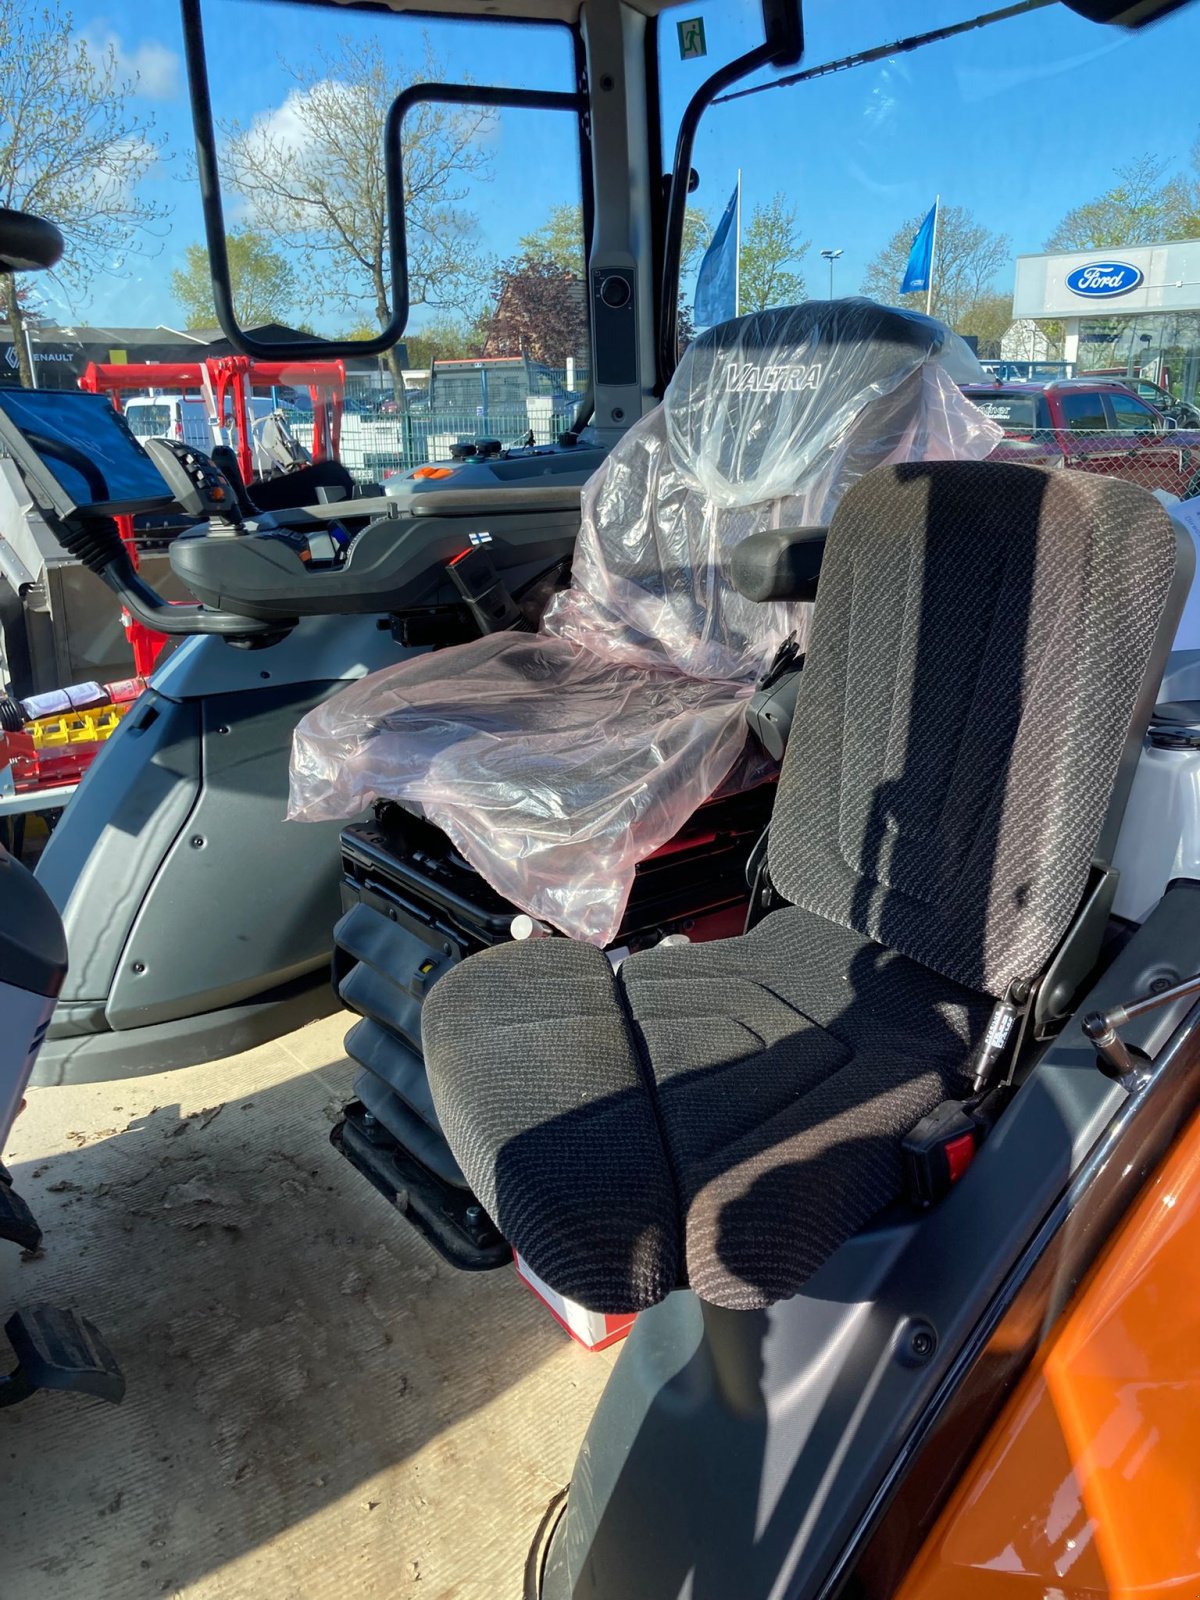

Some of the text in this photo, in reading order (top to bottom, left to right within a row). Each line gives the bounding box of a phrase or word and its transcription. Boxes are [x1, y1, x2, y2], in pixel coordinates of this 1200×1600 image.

[1078, 267, 1125, 289] Ford
[32, 353, 74, 362] ENAULT
[725, 362, 822, 392] VALTRA
